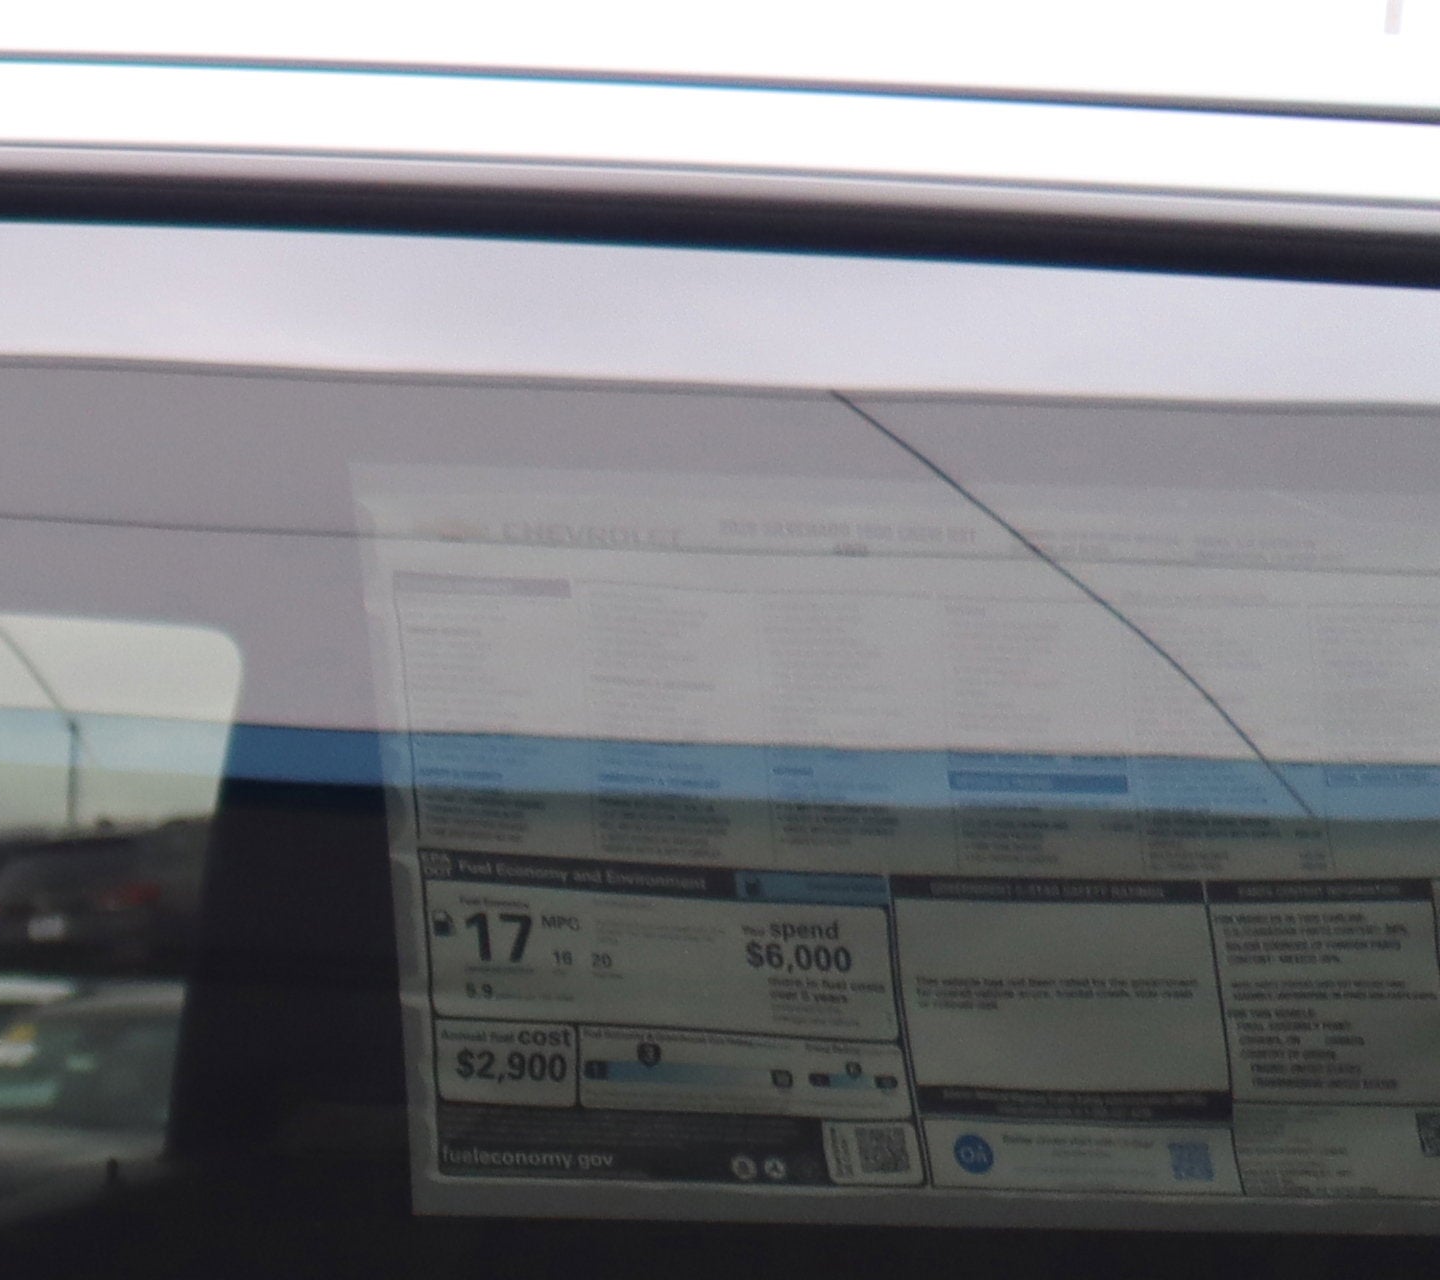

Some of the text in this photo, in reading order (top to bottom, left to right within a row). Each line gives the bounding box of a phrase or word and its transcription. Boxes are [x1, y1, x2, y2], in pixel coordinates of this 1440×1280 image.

[459, 860, 706, 889] Fuel Economy and Environment
[541, 915, 579, 932] MPG
[769, 920, 839, 942] spend
[466, 913, 531, 962] 17
[591, 952, 612, 968] 20
[746, 941, 851, 974] $6,000
[441, 1029, 486, 1041] Annual
[517, 1028, 571, 1047] cost
[456, 1047, 567, 1084] $2,900
[442, 1145, 613, 1171] fueleconomy.gov
